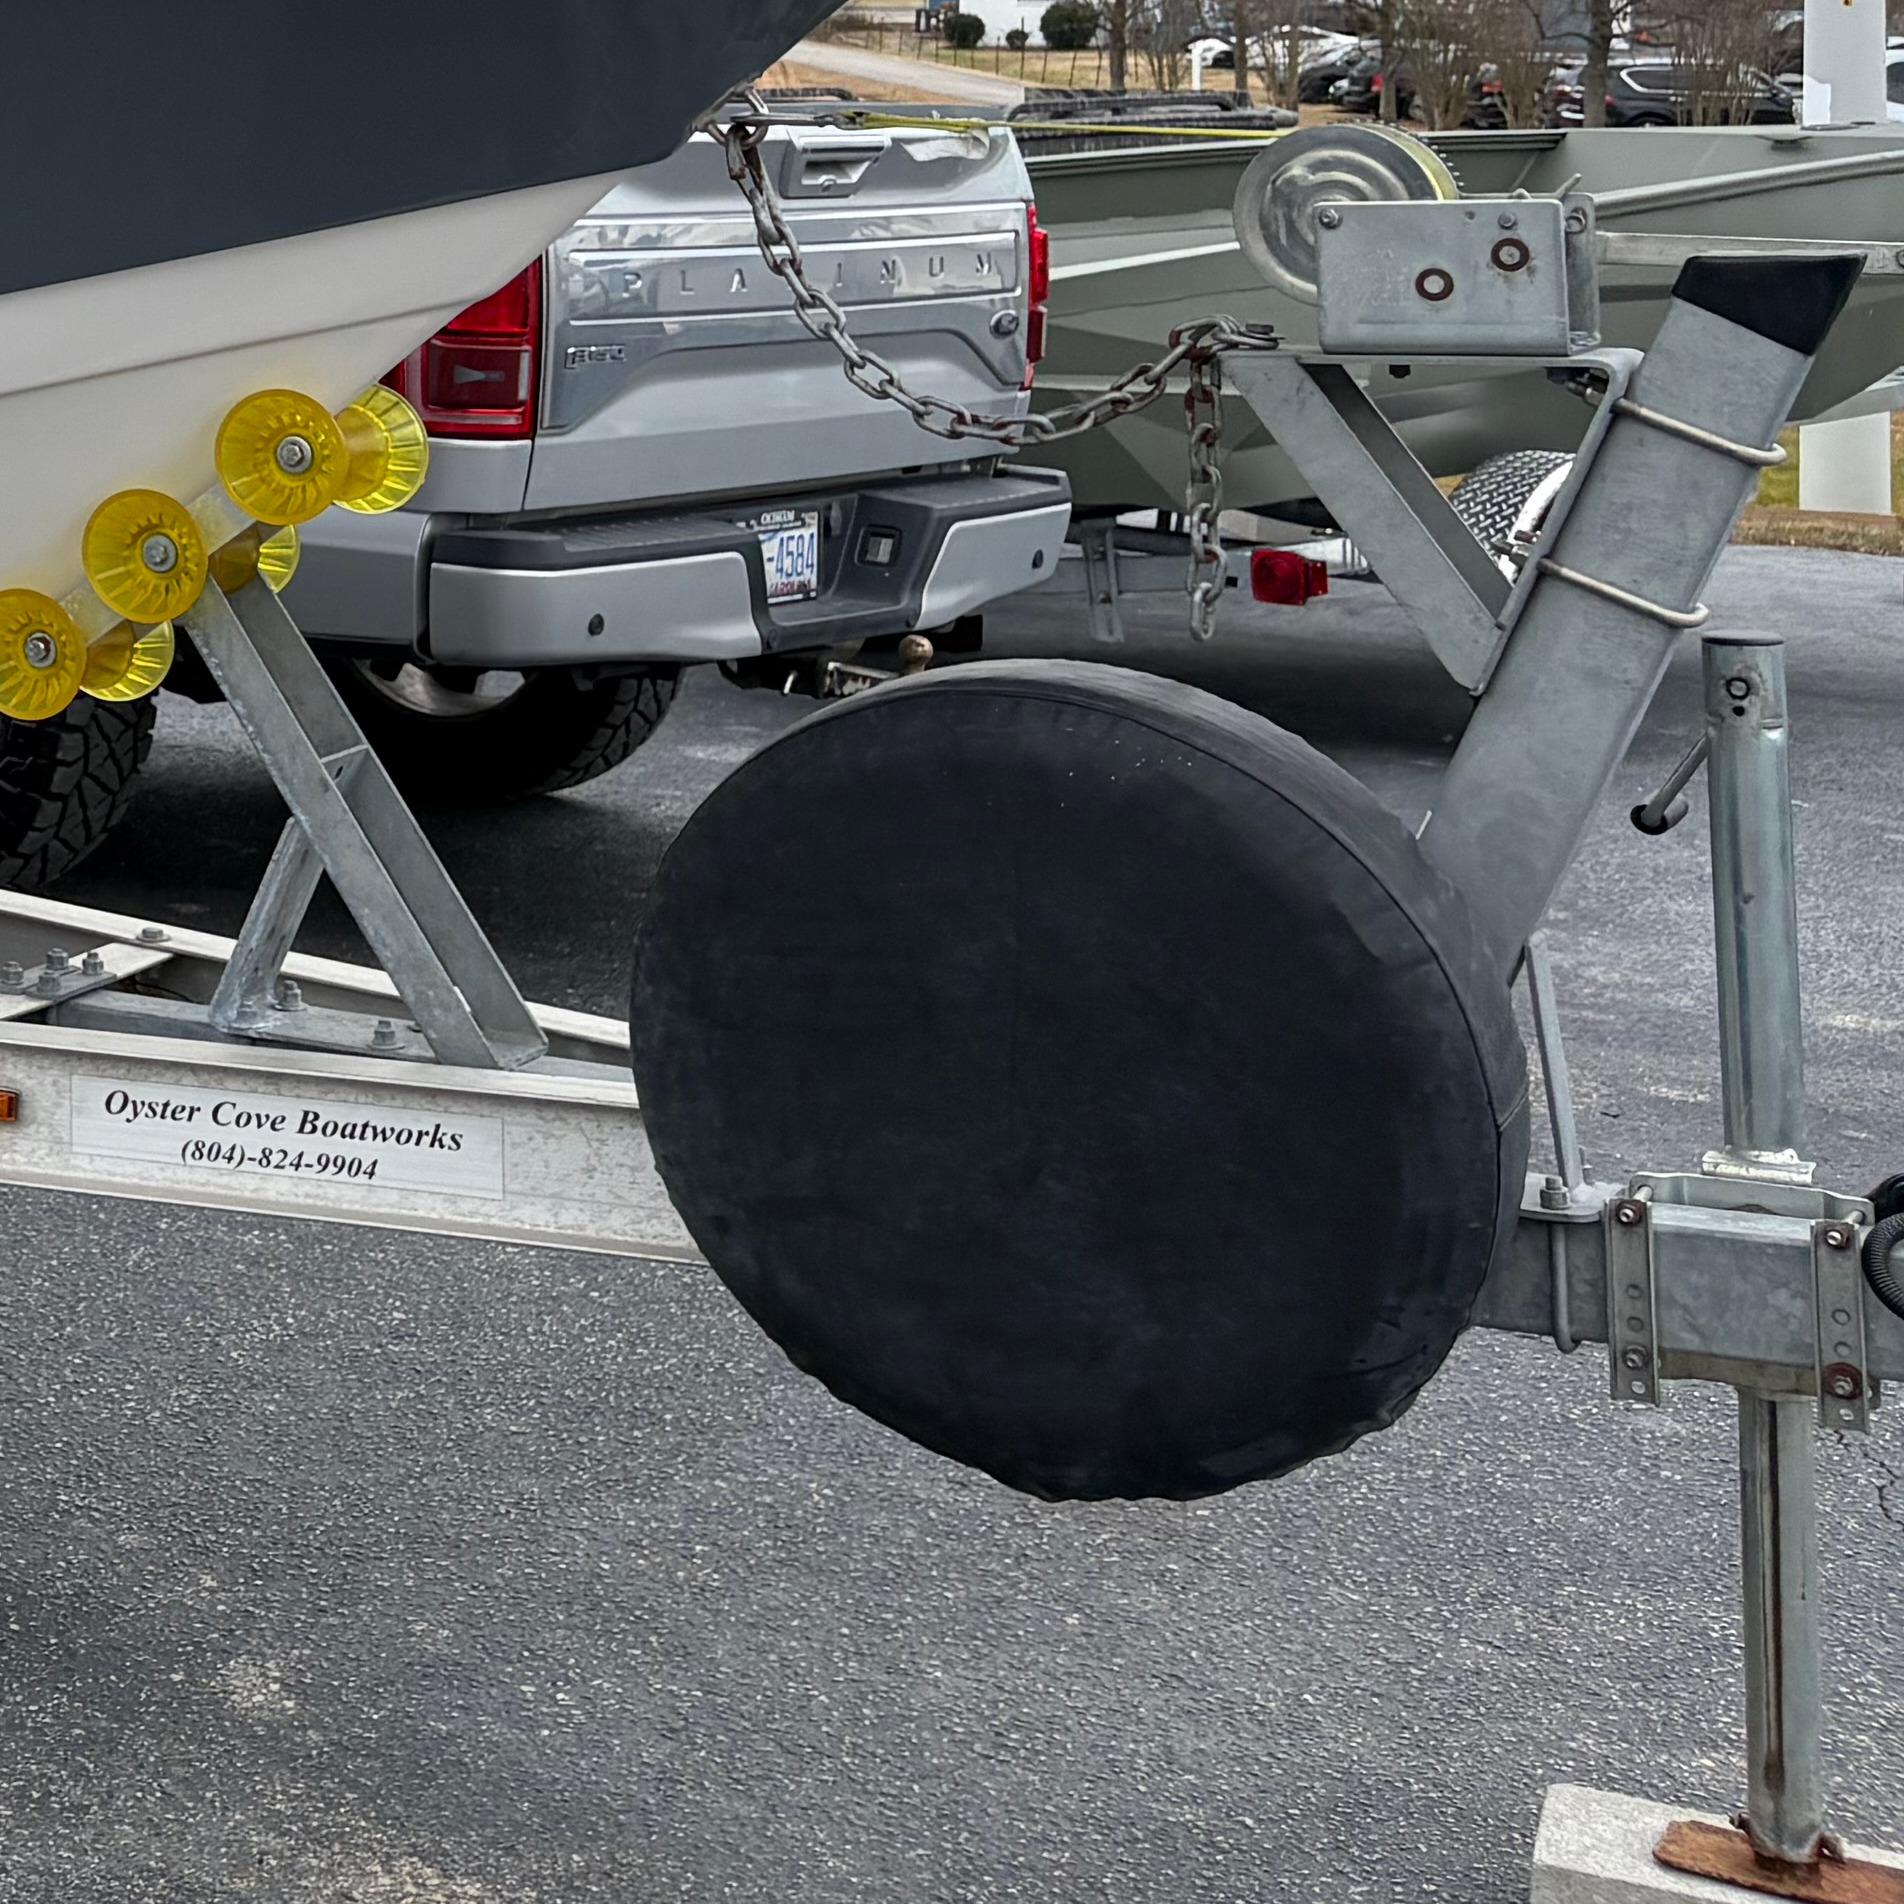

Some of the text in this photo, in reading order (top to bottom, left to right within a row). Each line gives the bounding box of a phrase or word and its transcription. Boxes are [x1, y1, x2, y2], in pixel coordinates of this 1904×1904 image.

[622, 252, 992, 298] PLAINUM
[104, 1089, 464, 1152] Oyster Cove Boatworks
[180, 1139, 379, 1180] (804)-824-9904
